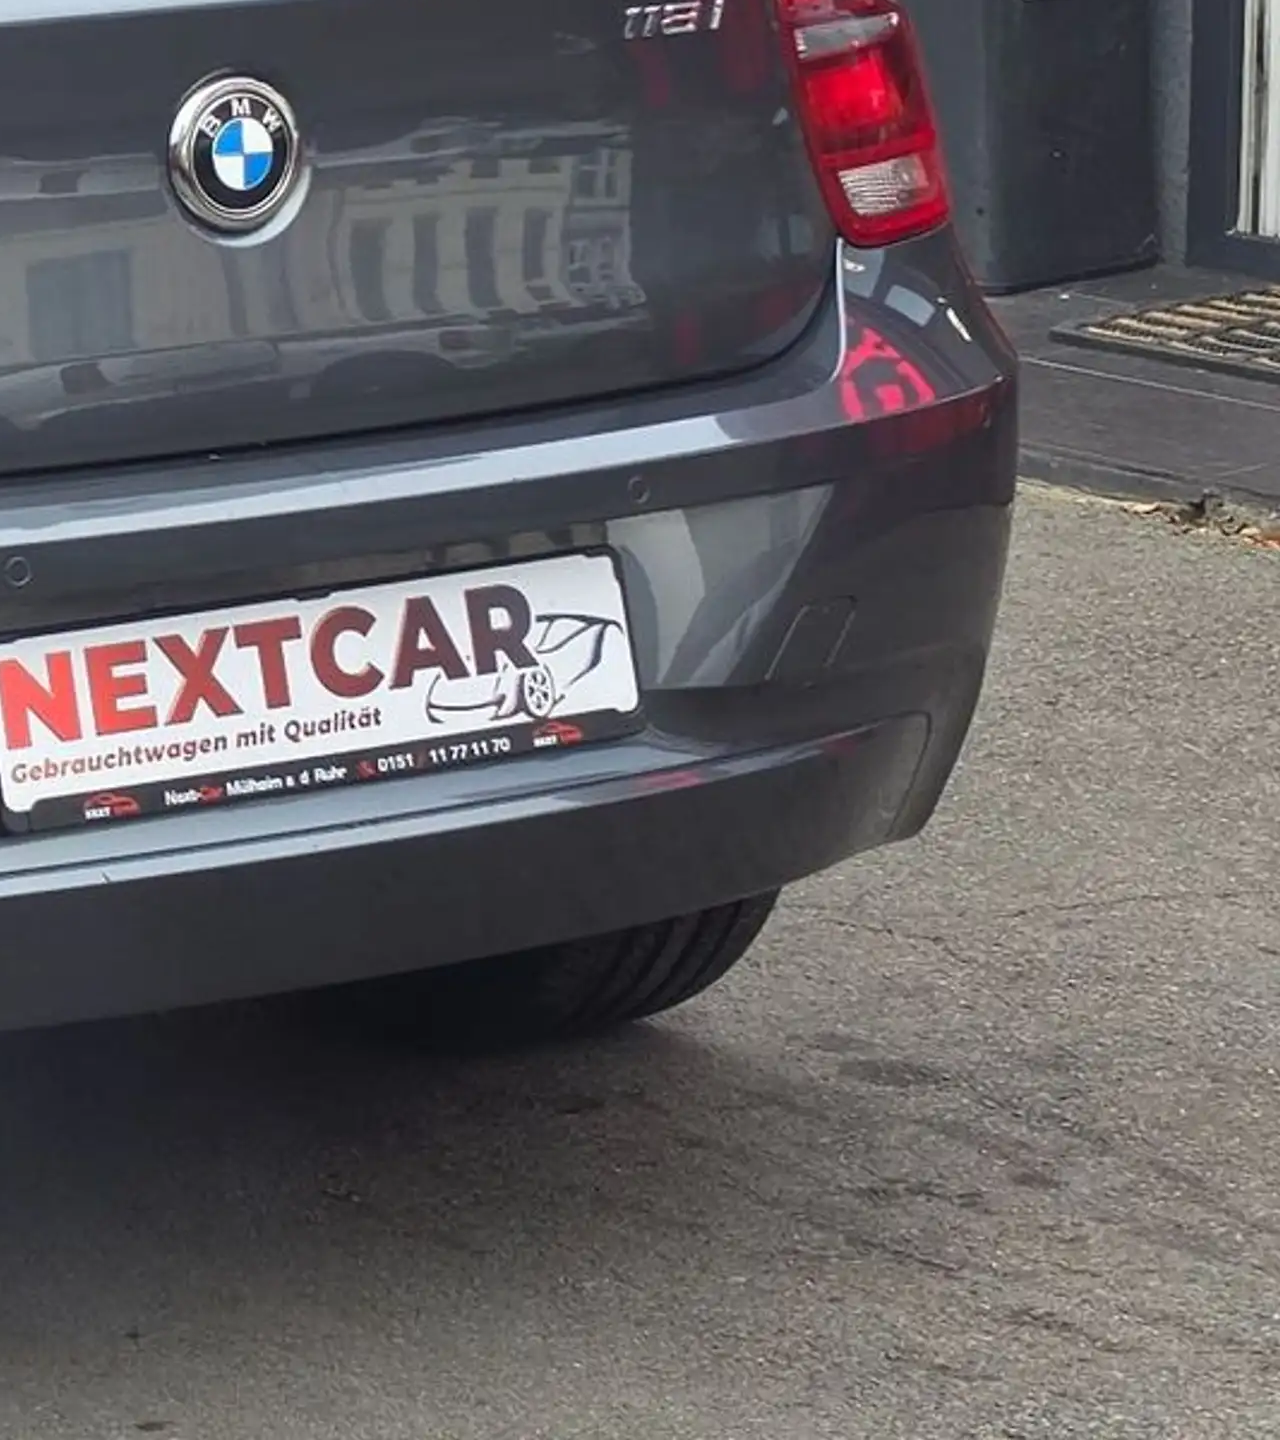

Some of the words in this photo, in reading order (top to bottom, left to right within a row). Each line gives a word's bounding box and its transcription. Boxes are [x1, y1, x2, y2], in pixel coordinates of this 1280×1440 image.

[200, 97, 282, 139] BMW
[10, 733, 228, 785] Gebrauchtwagen
[236, 722, 276, 749] mit
[284, 707, 382, 744] Qualität
[314, 764, 348, 783] Ruhr
[377, 752, 414, 773] 0151
[429, 746, 448, 764] 11
[450, 745, 468, 760] 77
[471, 740, 489, 758] 11
[491, 736, 511, 753] 70
